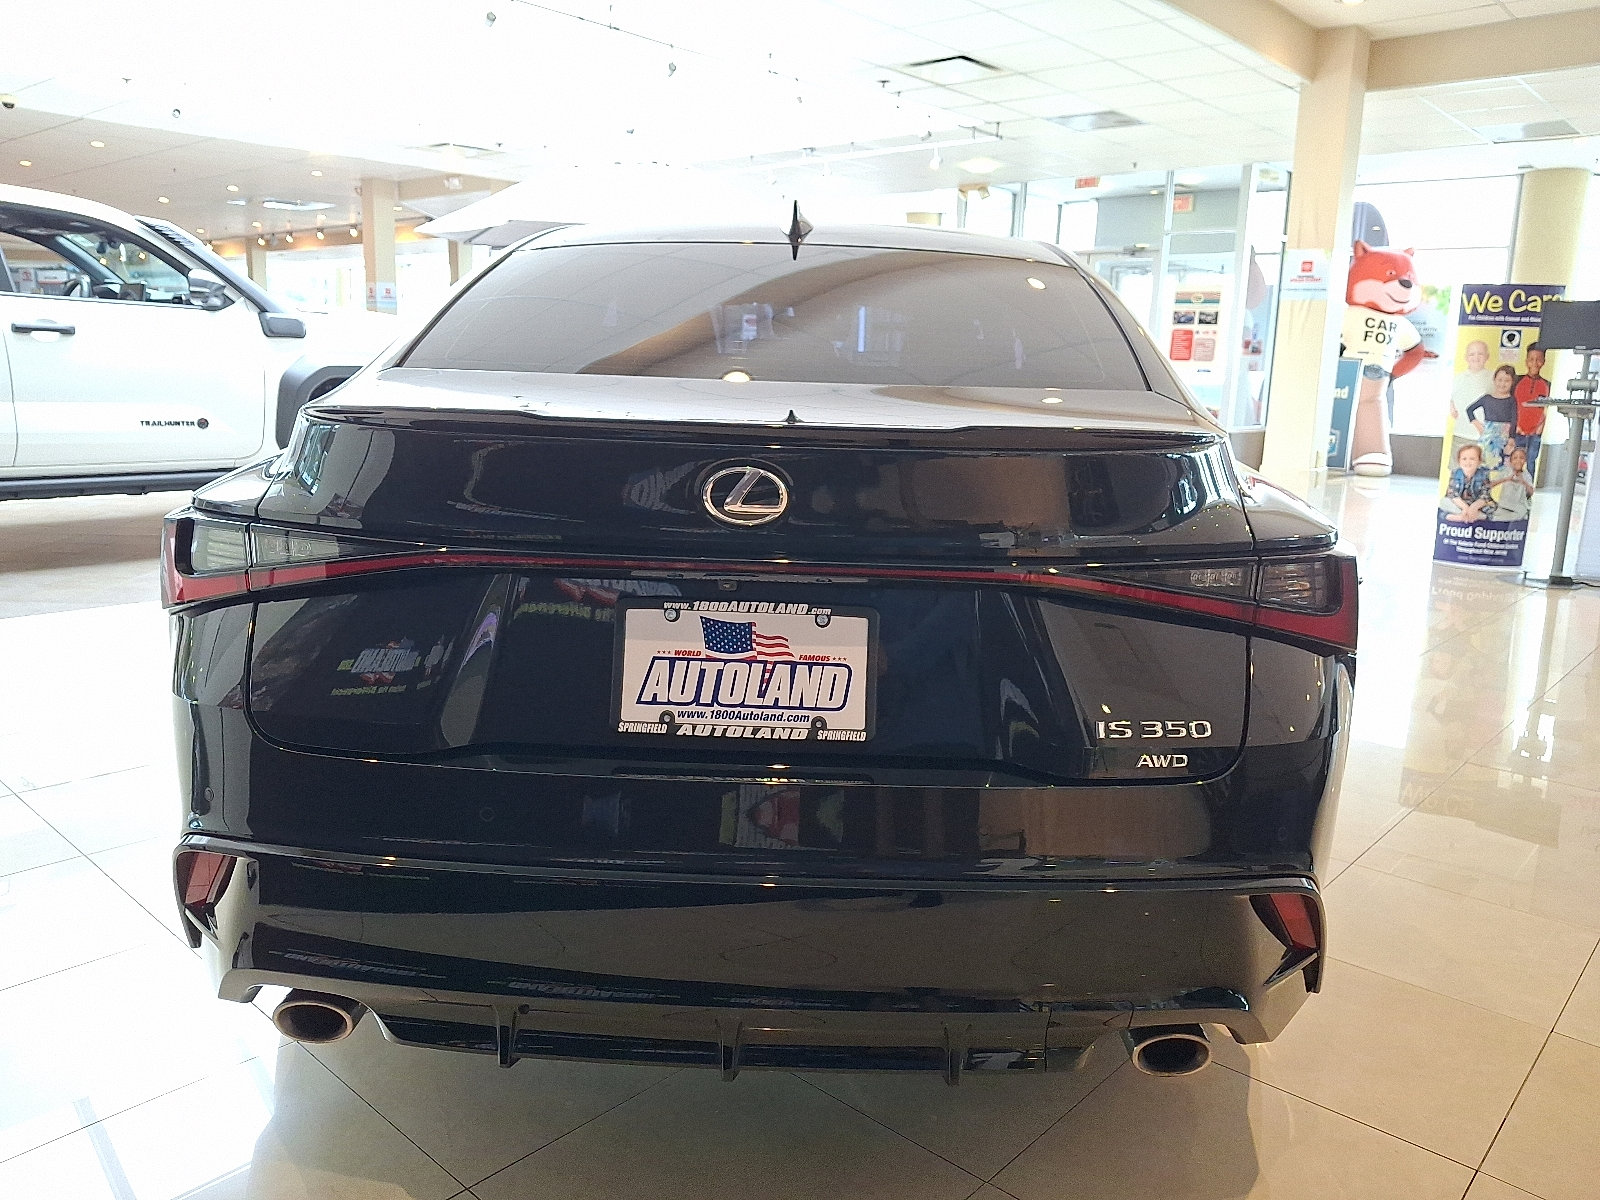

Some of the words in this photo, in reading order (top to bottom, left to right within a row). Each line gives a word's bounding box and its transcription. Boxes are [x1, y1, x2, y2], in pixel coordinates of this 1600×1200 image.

[1462, 290, 1504, 315] We
[1365, 317, 1398, 332] CAR
[1363, 330, 1393, 345] FOX
[1439, 523, 1473, 539] Proud
[1474, 526, 1525, 542] Supporter
[798, 654, 831, 662] FAMOUS
[636, 656, 852, 711] AUTOLAND
[677, 709, 810, 723] www.1800Autoland.com
[618, 721, 668, 734] SPRINGFIELD
[676, 725, 809, 740] AUTOLAND
[1096, 720, 1133, 739] IS
[1139, 720, 1212, 739] 350
[817, 730, 867, 742] SPRINGFIELD
[1136, 754, 1188, 768] AWD
